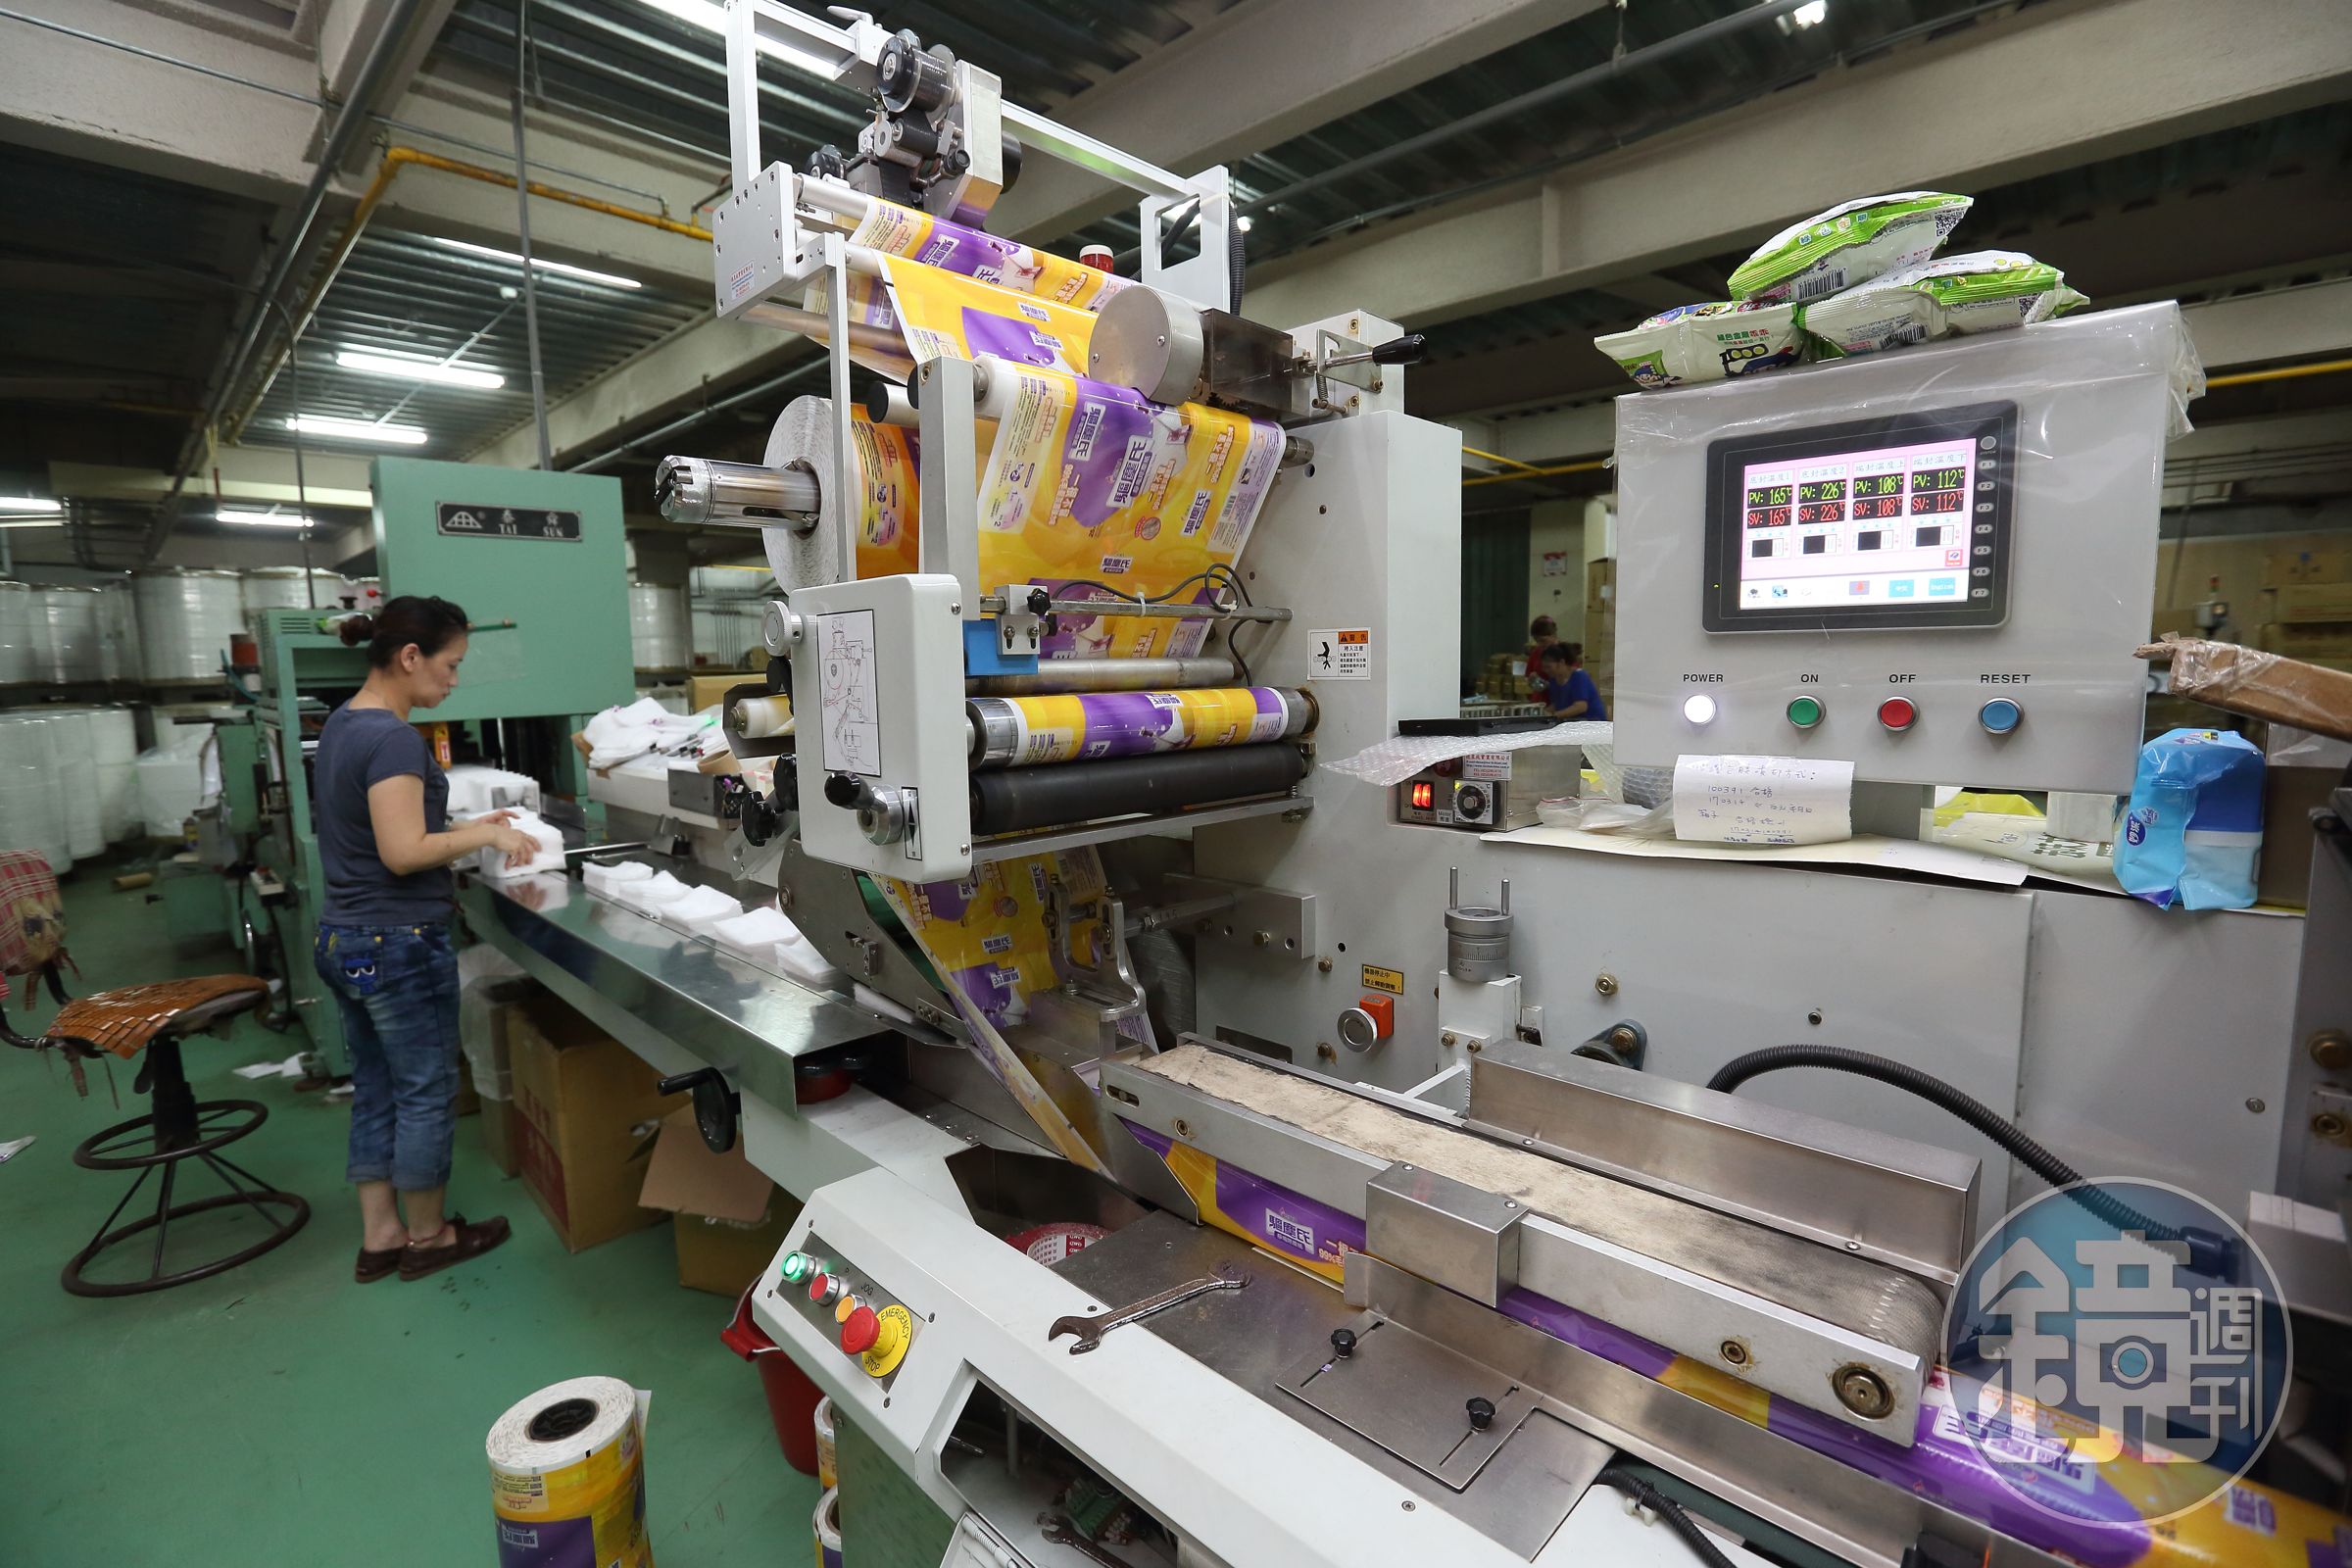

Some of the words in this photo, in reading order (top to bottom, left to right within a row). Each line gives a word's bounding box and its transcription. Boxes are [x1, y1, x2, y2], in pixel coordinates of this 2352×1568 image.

[1855, 480, 1871, 494] PV:
[1913, 474, 1931, 488] PV:
[1748, 491, 1763, 505] PV:
[1800, 486, 1815, 499] PV:
[1854, 503, 1871, 515] SV:
[1912, 497, 1929, 511] SV:
[1748, 513, 1763, 525] SV:
[1799, 508, 1814, 520] SV:
[1683, 673, 1724, 683] POWER
[1800, 674, 1819, 683] ON
[1888, 673, 1916, 683] OFF
[1980, 674, 2031, 684] RESET
[1269, 1214, 1311, 1246] 驅塵氏
[860, 1283, 874, 1296] JOG
[880, 1307, 909, 1340] EMERGENCY
[864, 1355, 881, 1372] STOP
